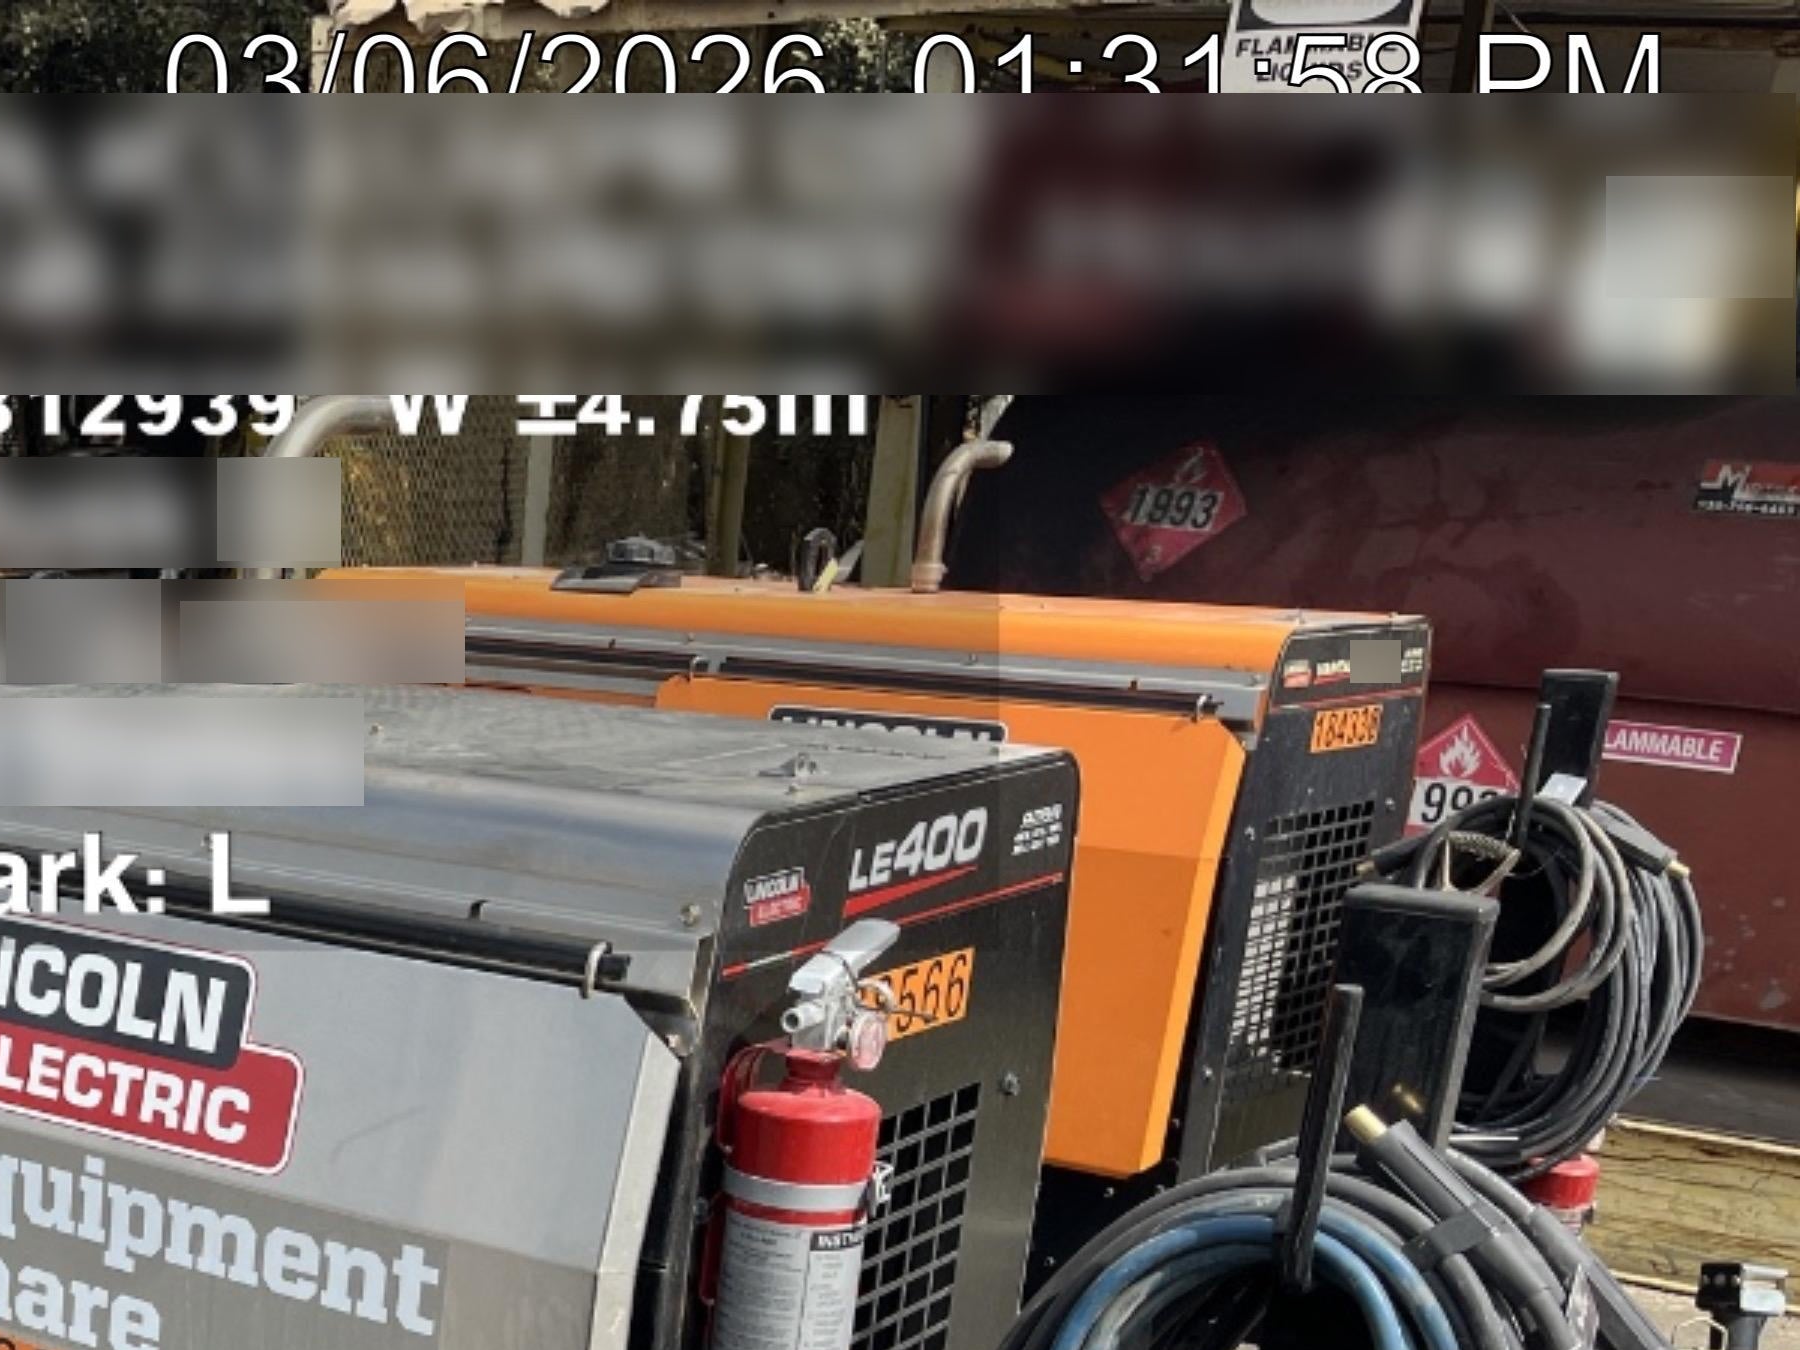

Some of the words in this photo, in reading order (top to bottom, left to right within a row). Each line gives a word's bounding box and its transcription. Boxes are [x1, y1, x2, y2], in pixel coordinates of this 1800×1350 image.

[1130, 485, 1219, 529] 1993
[1604, 728, 1724, 762] LAMMABLE
[848, 807, 988, 893] LE400
